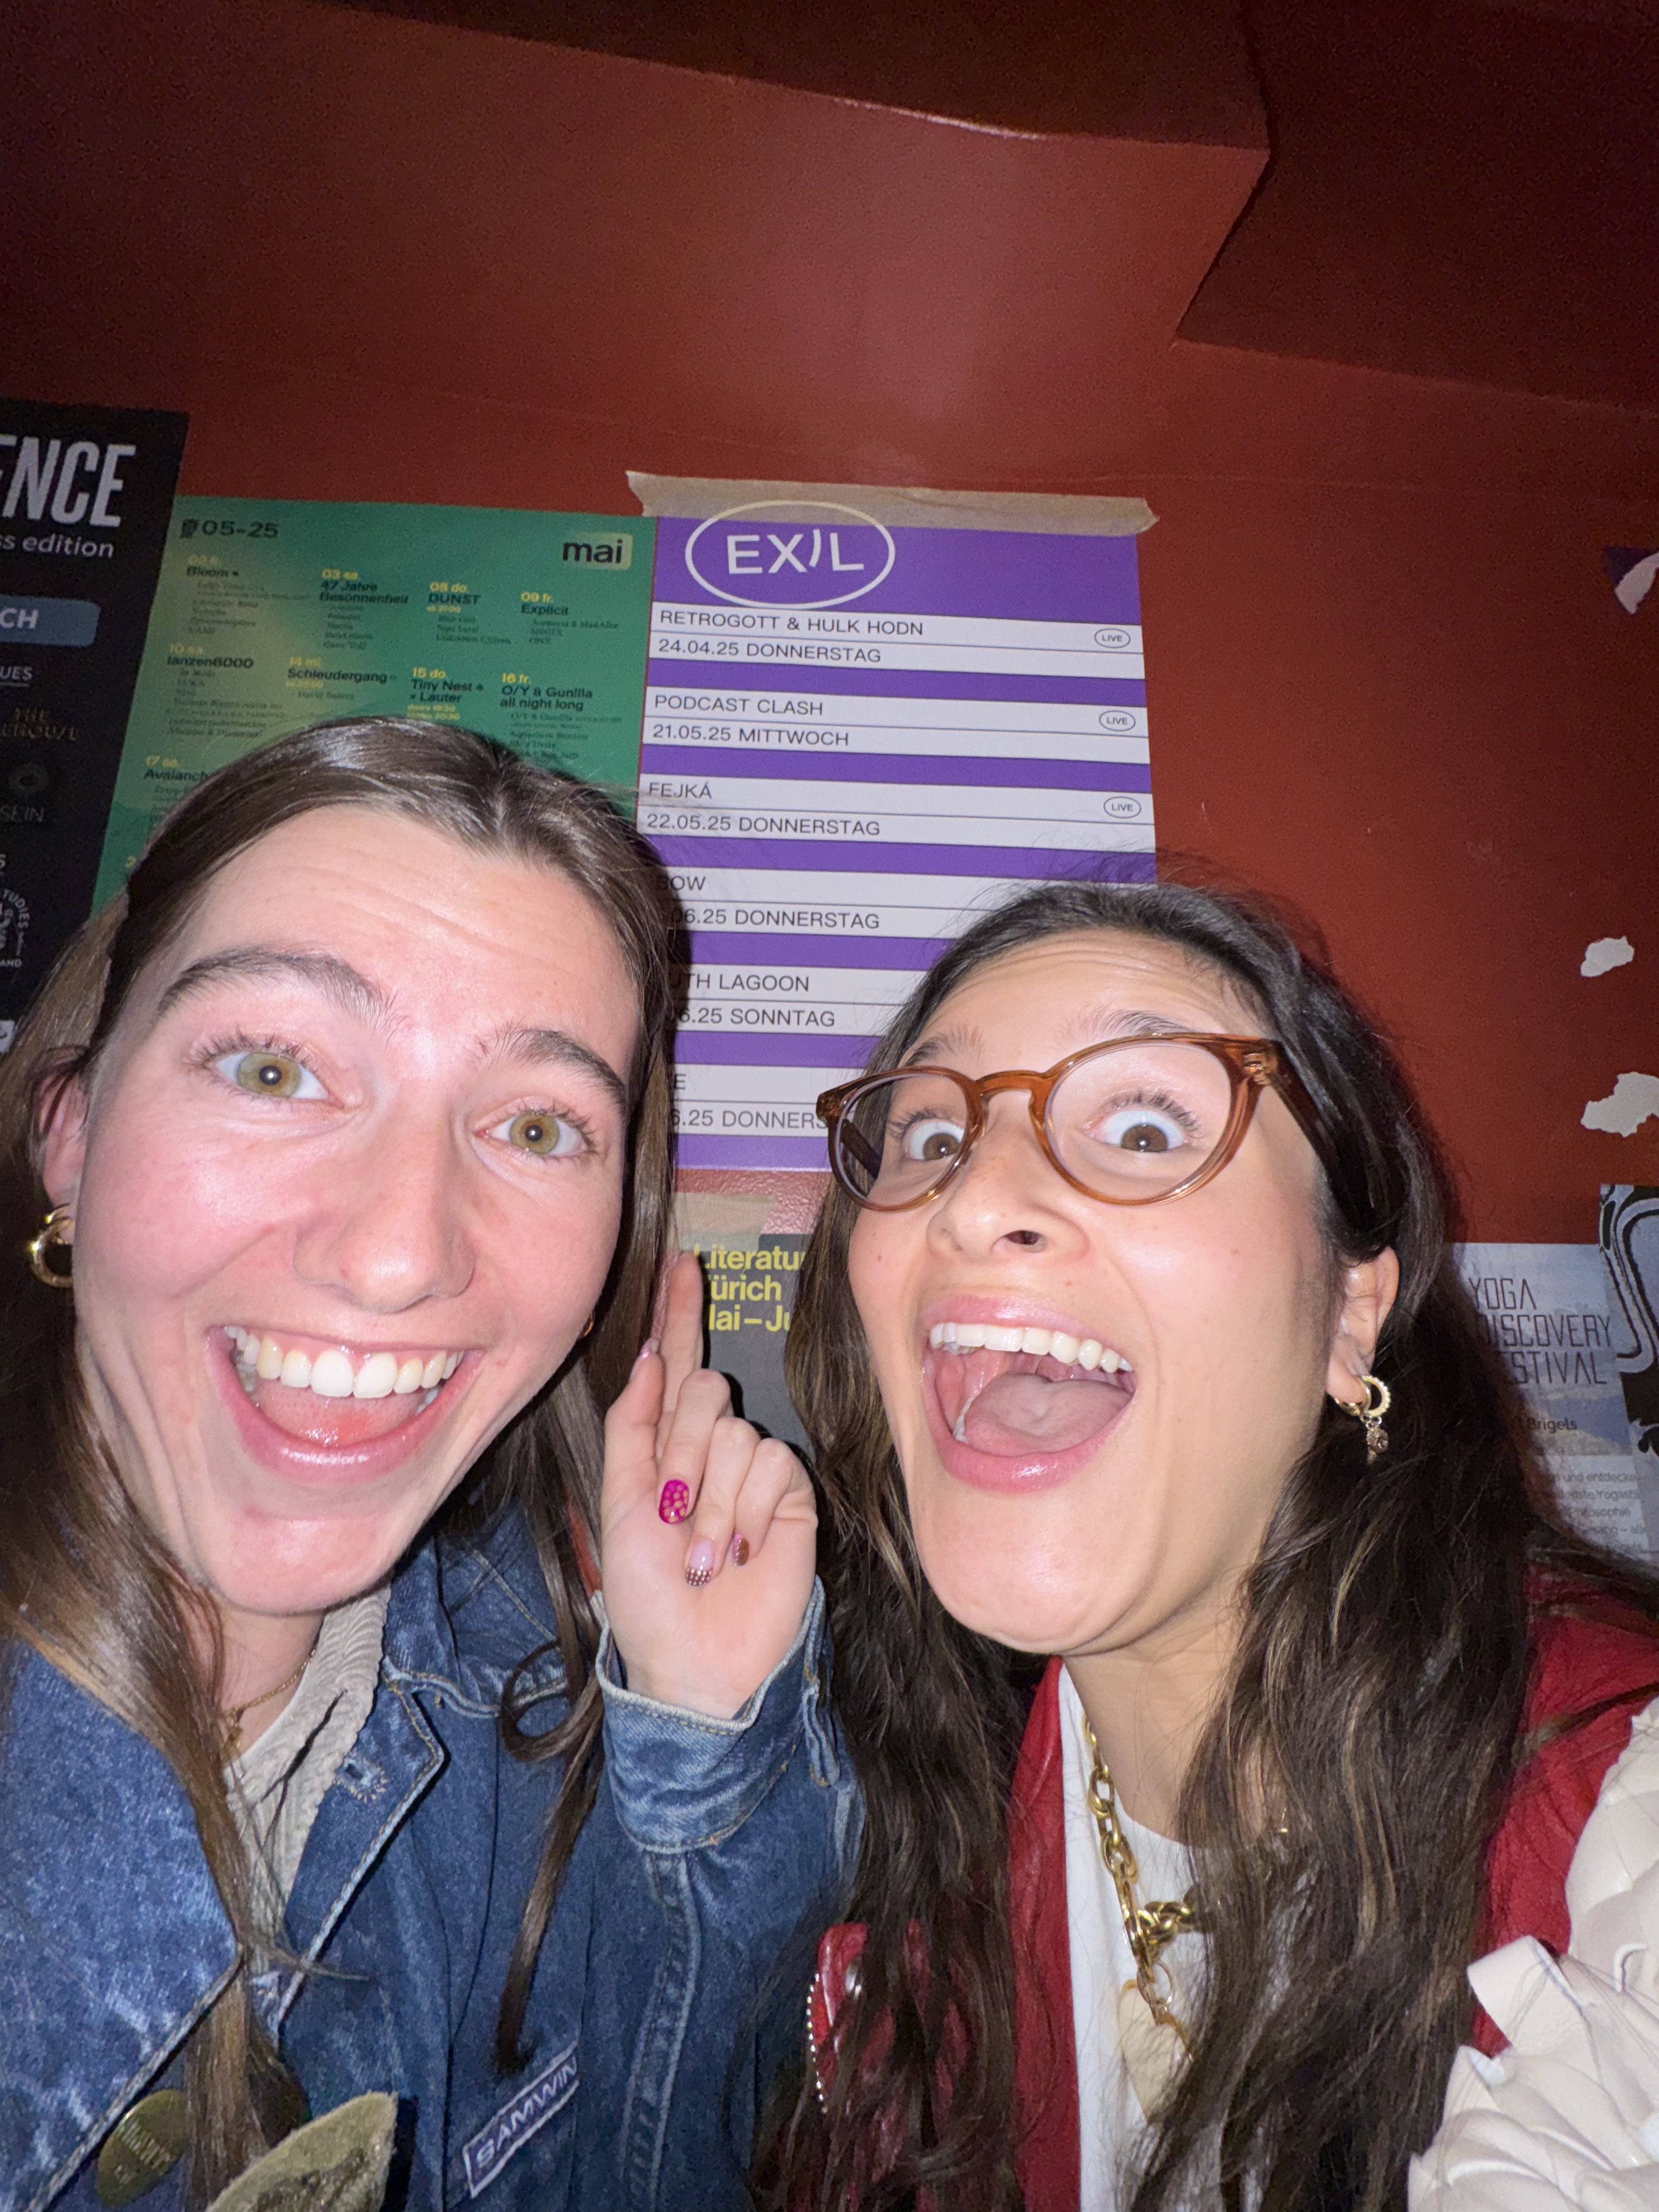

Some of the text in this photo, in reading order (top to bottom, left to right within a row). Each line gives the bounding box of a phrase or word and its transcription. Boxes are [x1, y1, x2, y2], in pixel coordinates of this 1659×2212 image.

[22, 533, 114, 558] edition
[562, 538, 623, 563] mai
[727, 528, 865, 574] EXIL
[187, 566, 229, 577] Bloom
[321, 580, 378, 592] 47 Jahre
[319, 591, 409, 604] Besonnenheit
[428, 592, 481, 605] DUNST
[521, 591, 540, 603] 09
[521, 603, 568, 616] Explicit
[660, 610, 923, 636] RETROGOTT & HULK HODN
[1101, 634, 1122, 642] LIVE
[659, 639, 881, 662] 24.04.25 DONNERSTAG
[287, 667, 388, 685] Schleudergang
[413, 667, 427, 678] 15
[501, 673, 516, 684] 16
[411, 679, 473, 692] Tiny Nest
[501, 685, 529, 696] O/Y
[545, 686, 593, 699] Gunilla
[420, 691, 463, 703] Lauter
[499, 697, 584, 712] all night long
[654, 695, 823, 715] PODCAST CLASH
[1106, 716, 1127, 725] LIVE
[653, 724, 849, 746] 21.05.25 MITTWOCH
[648, 781, 712, 799] FEJKÁ
[1111, 804, 1133, 812] LIVE
[647, 813, 881, 835] 22.05.25 DONNERSTAG
[735, 910, 879, 928] DONNERSTAG
[719, 974, 809, 991] LAGOON
[730, 1008, 835, 1027] SONNTAG
[708, 1274, 782, 1301] ürich
[1468, 1277, 1537, 1311] YOGA
[1527, 1417, 1578, 1434] Brigels
